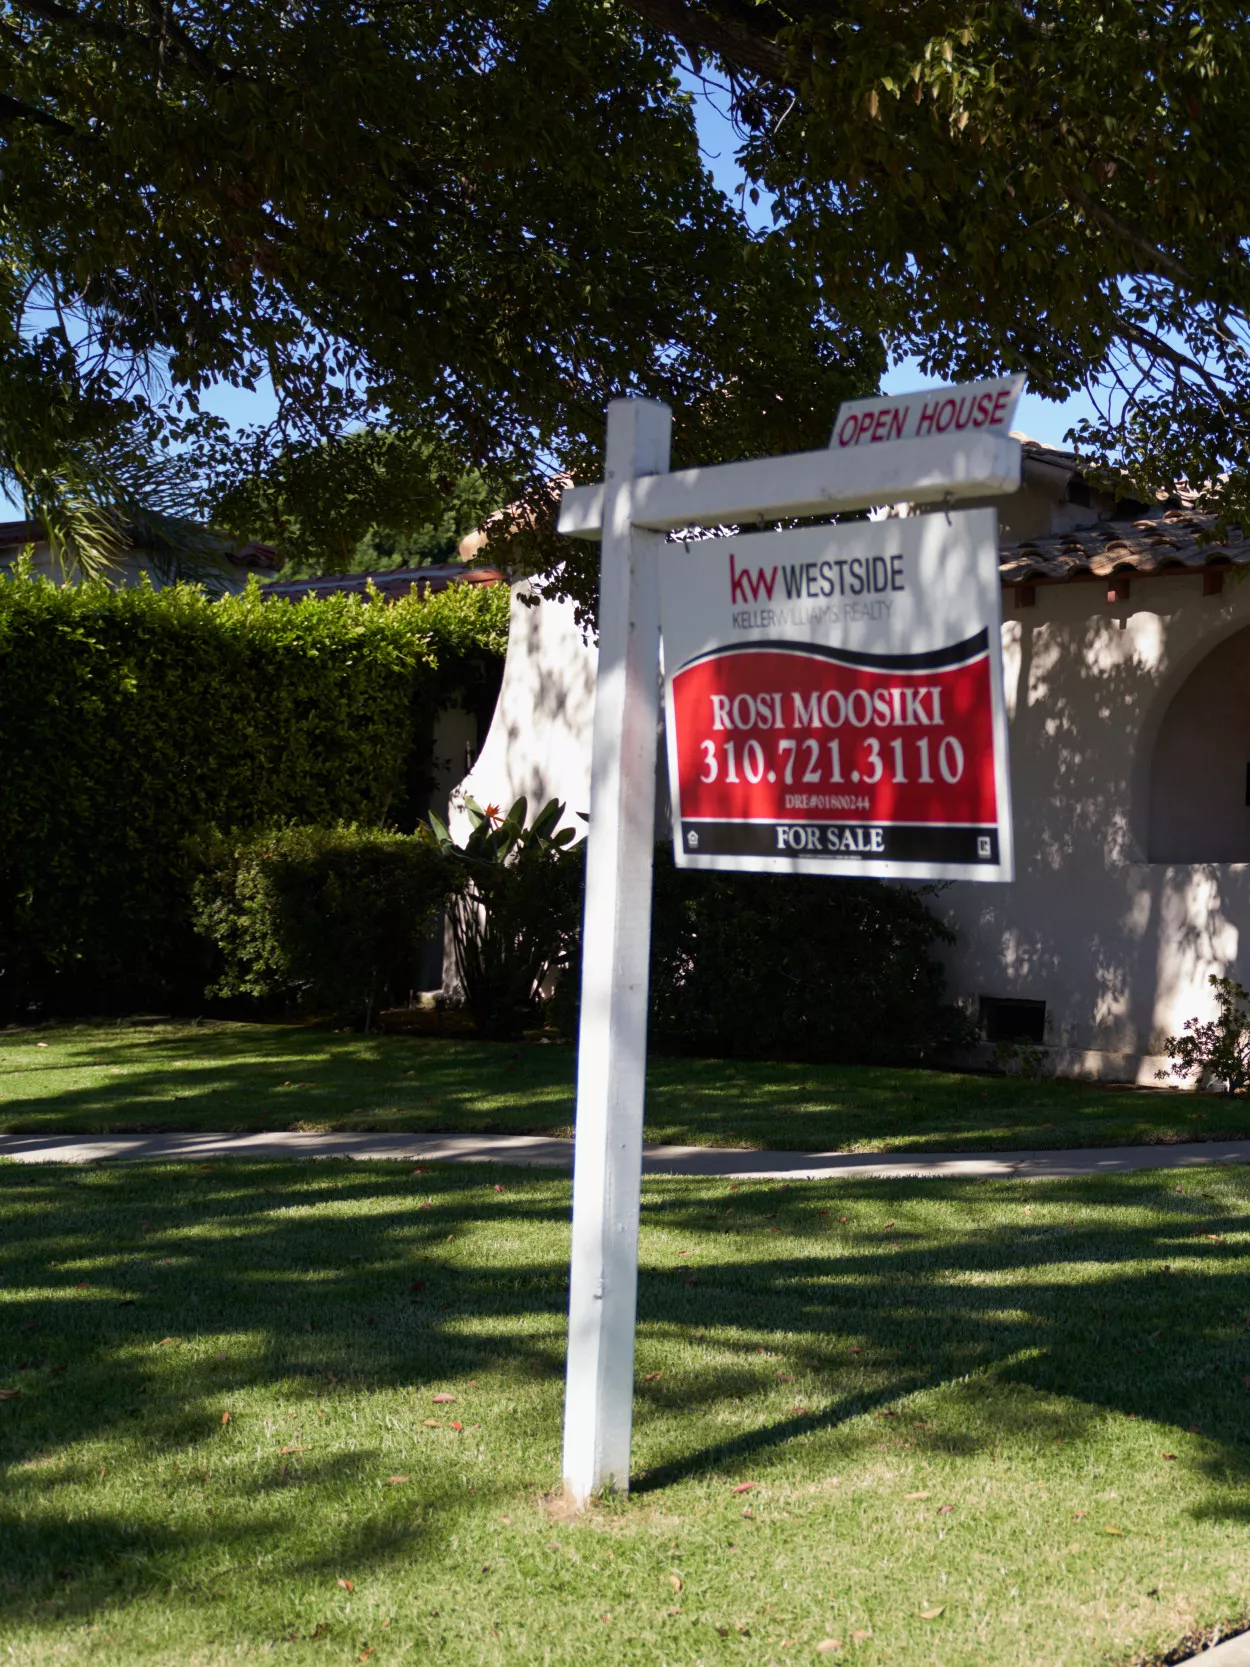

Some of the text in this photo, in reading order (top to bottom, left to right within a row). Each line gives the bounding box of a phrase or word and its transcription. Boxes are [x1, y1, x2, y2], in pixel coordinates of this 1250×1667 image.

[838, 390, 1012, 448] OPEN HOUSE
[782, 554, 906, 600] WESTSIDE
[844, 600, 894, 623] REALTY
[710, 686, 945, 731] ROSI MOOSIKI
[700, 735, 965, 786] 310.721.3110
[776, 826, 886, 852] FOR SALE
